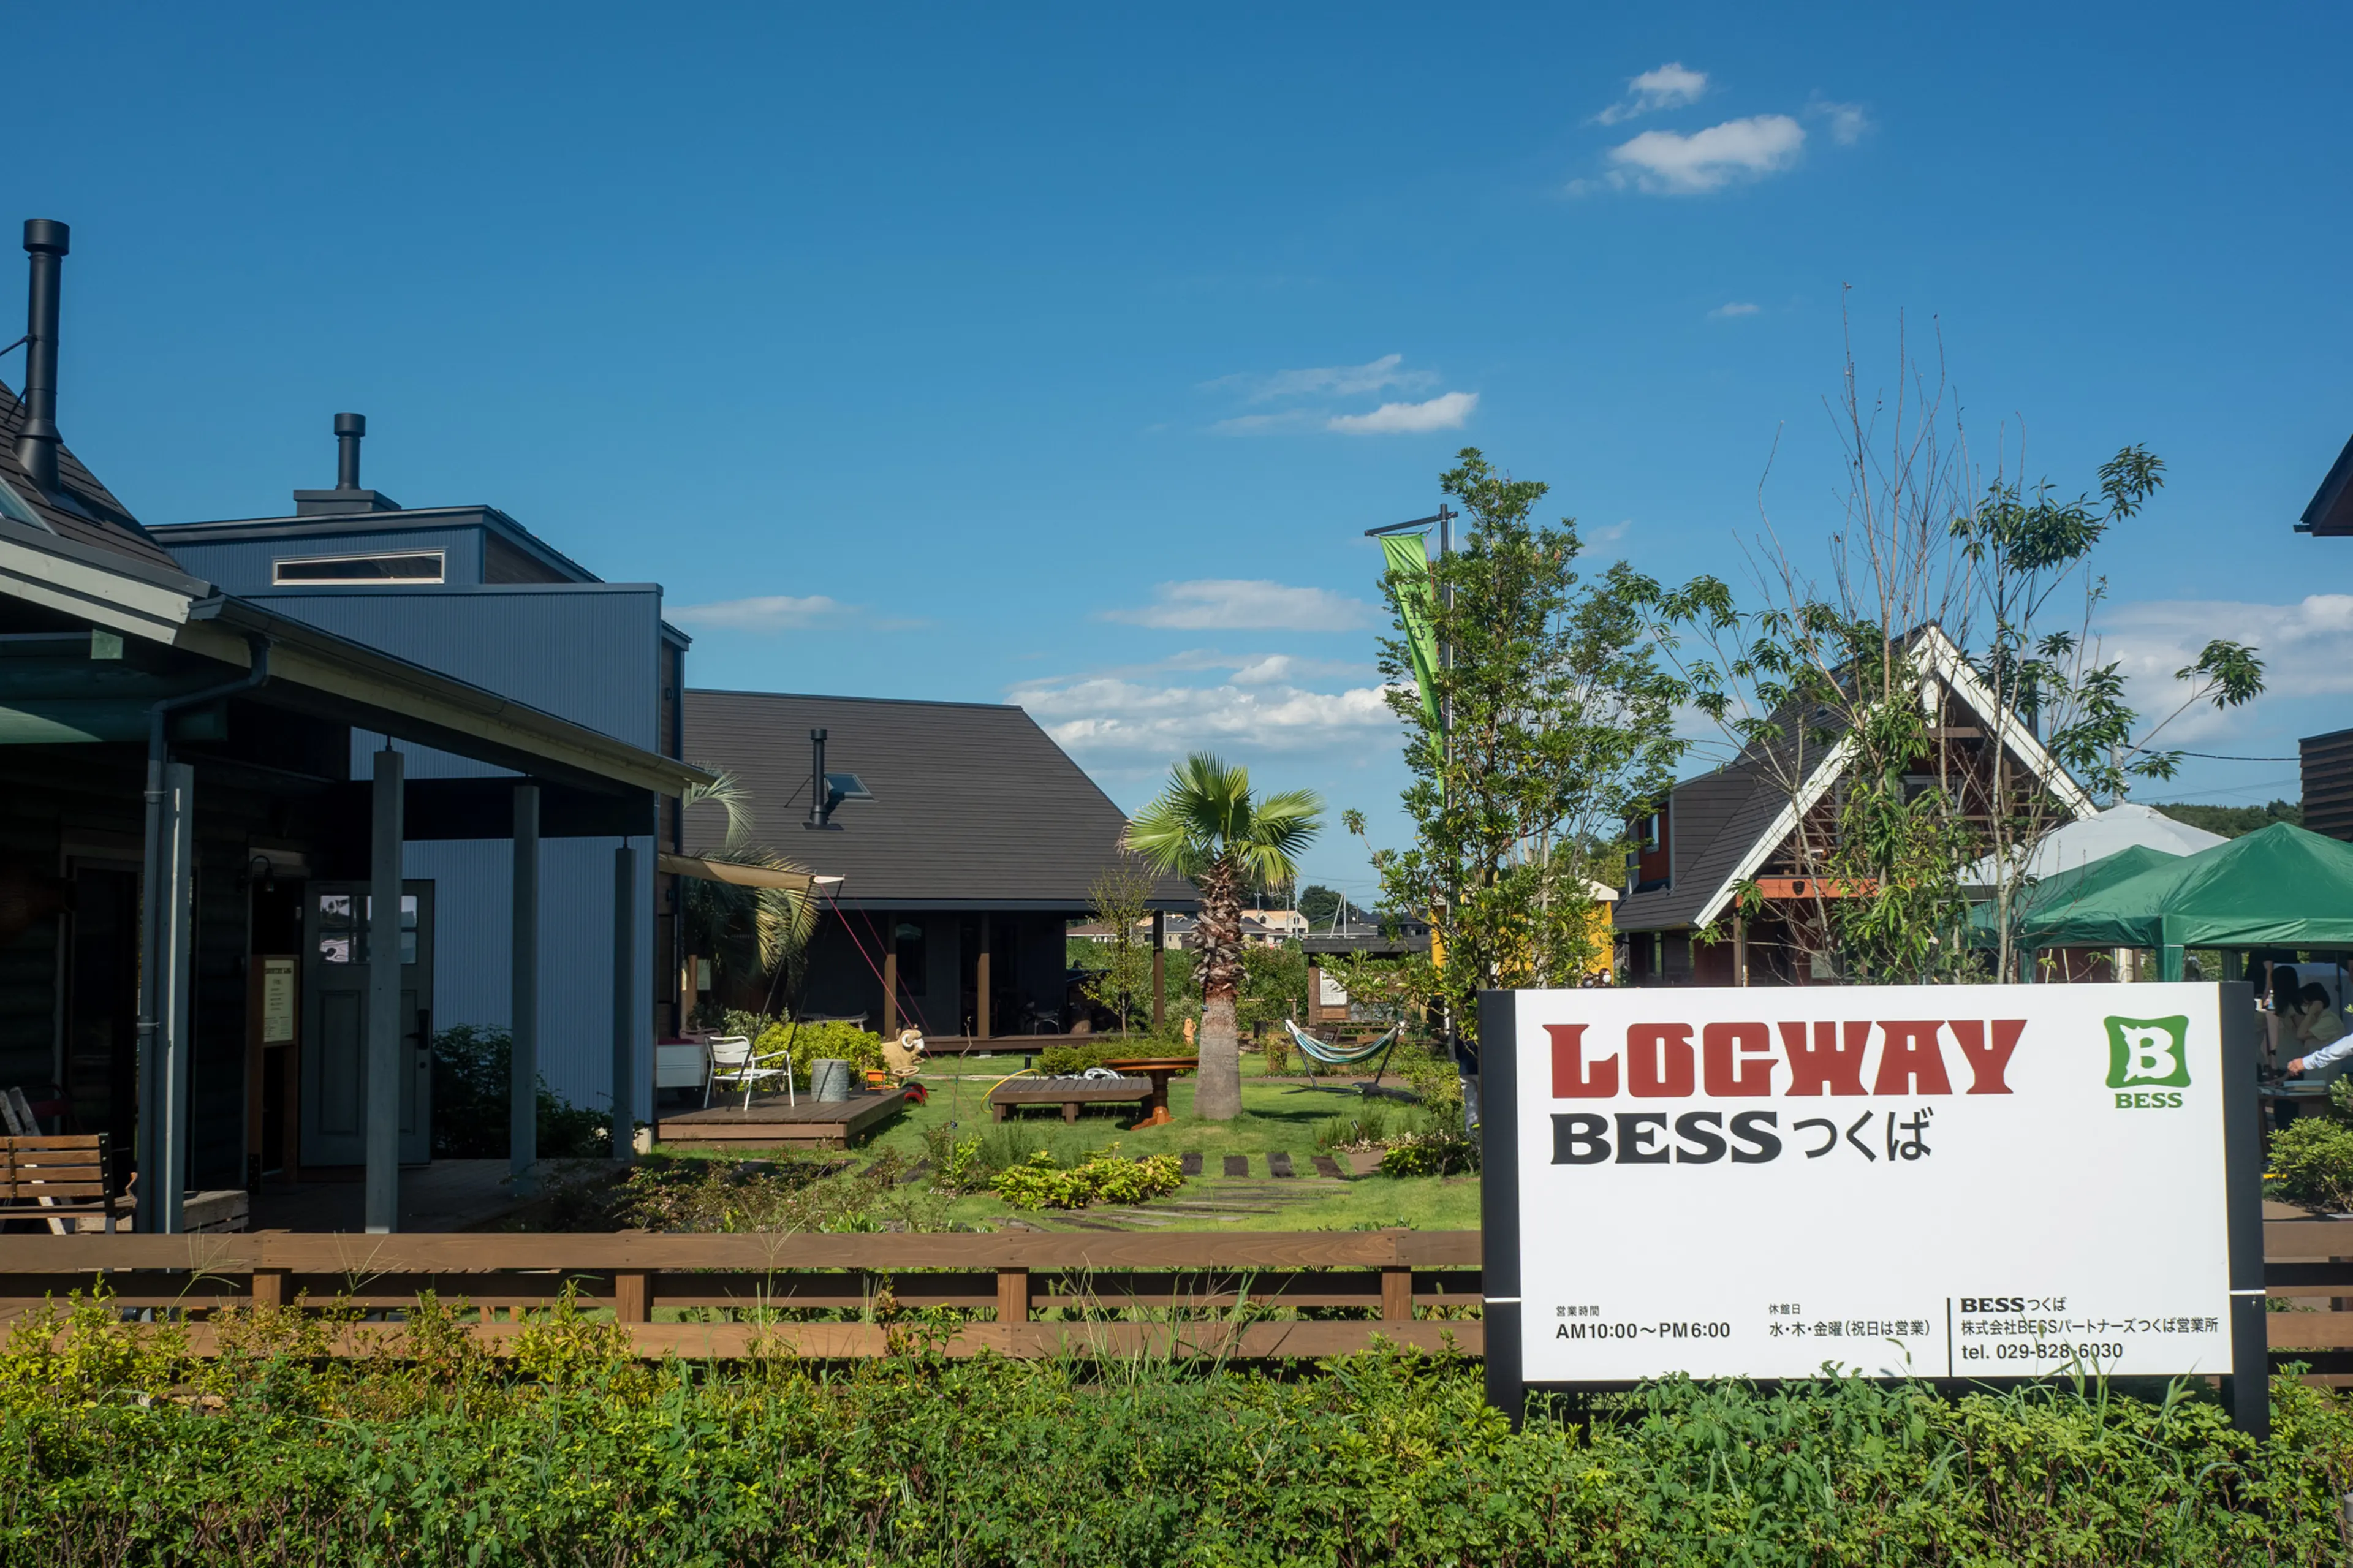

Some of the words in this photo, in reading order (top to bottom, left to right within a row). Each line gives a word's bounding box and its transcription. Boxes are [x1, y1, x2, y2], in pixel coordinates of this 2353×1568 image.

[1542, 1020, 2027, 1098] LOGWAY
[2115, 1093, 2183, 1108] BESS
[1550, 1107, 1933, 1165] BESSつくば
[1556, 1306, 1599, 1316] 営業時間
[1769, 1304, 1800, 1314] 休館日
[1961, 1344, 1990, 1360] tel.
